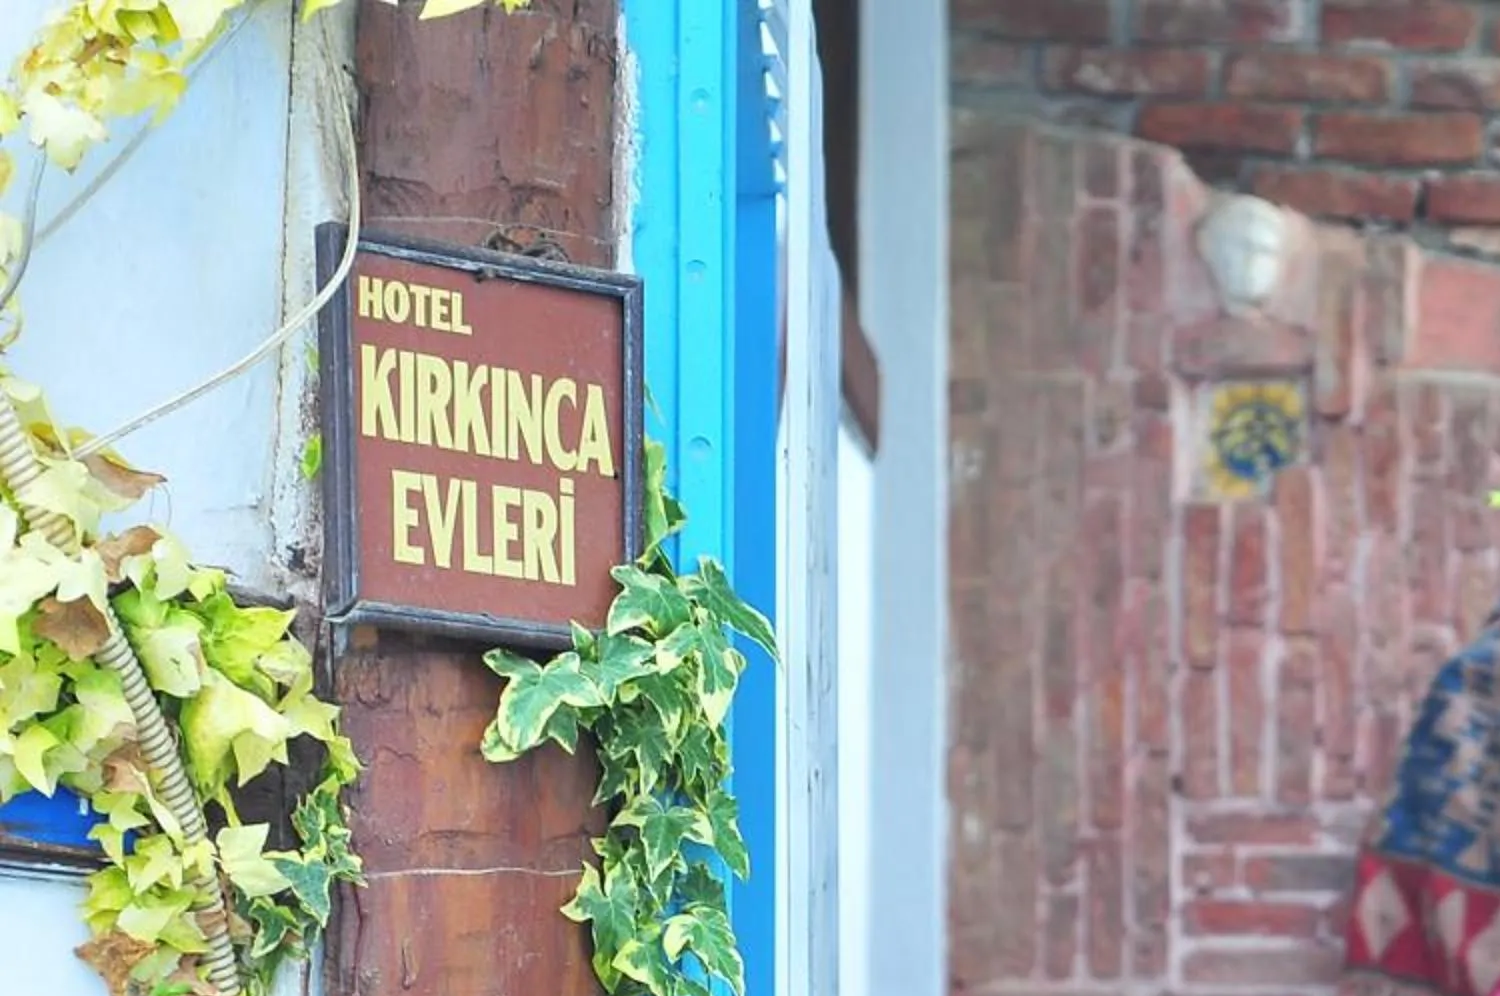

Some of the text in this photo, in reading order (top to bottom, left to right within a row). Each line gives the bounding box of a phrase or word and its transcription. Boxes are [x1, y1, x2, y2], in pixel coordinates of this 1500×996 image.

[358, 276, 473, 335] HOTEL
[361, 344, 614, 477] KIRKINCA
[392, 469, 576, 586] EVLERİ
